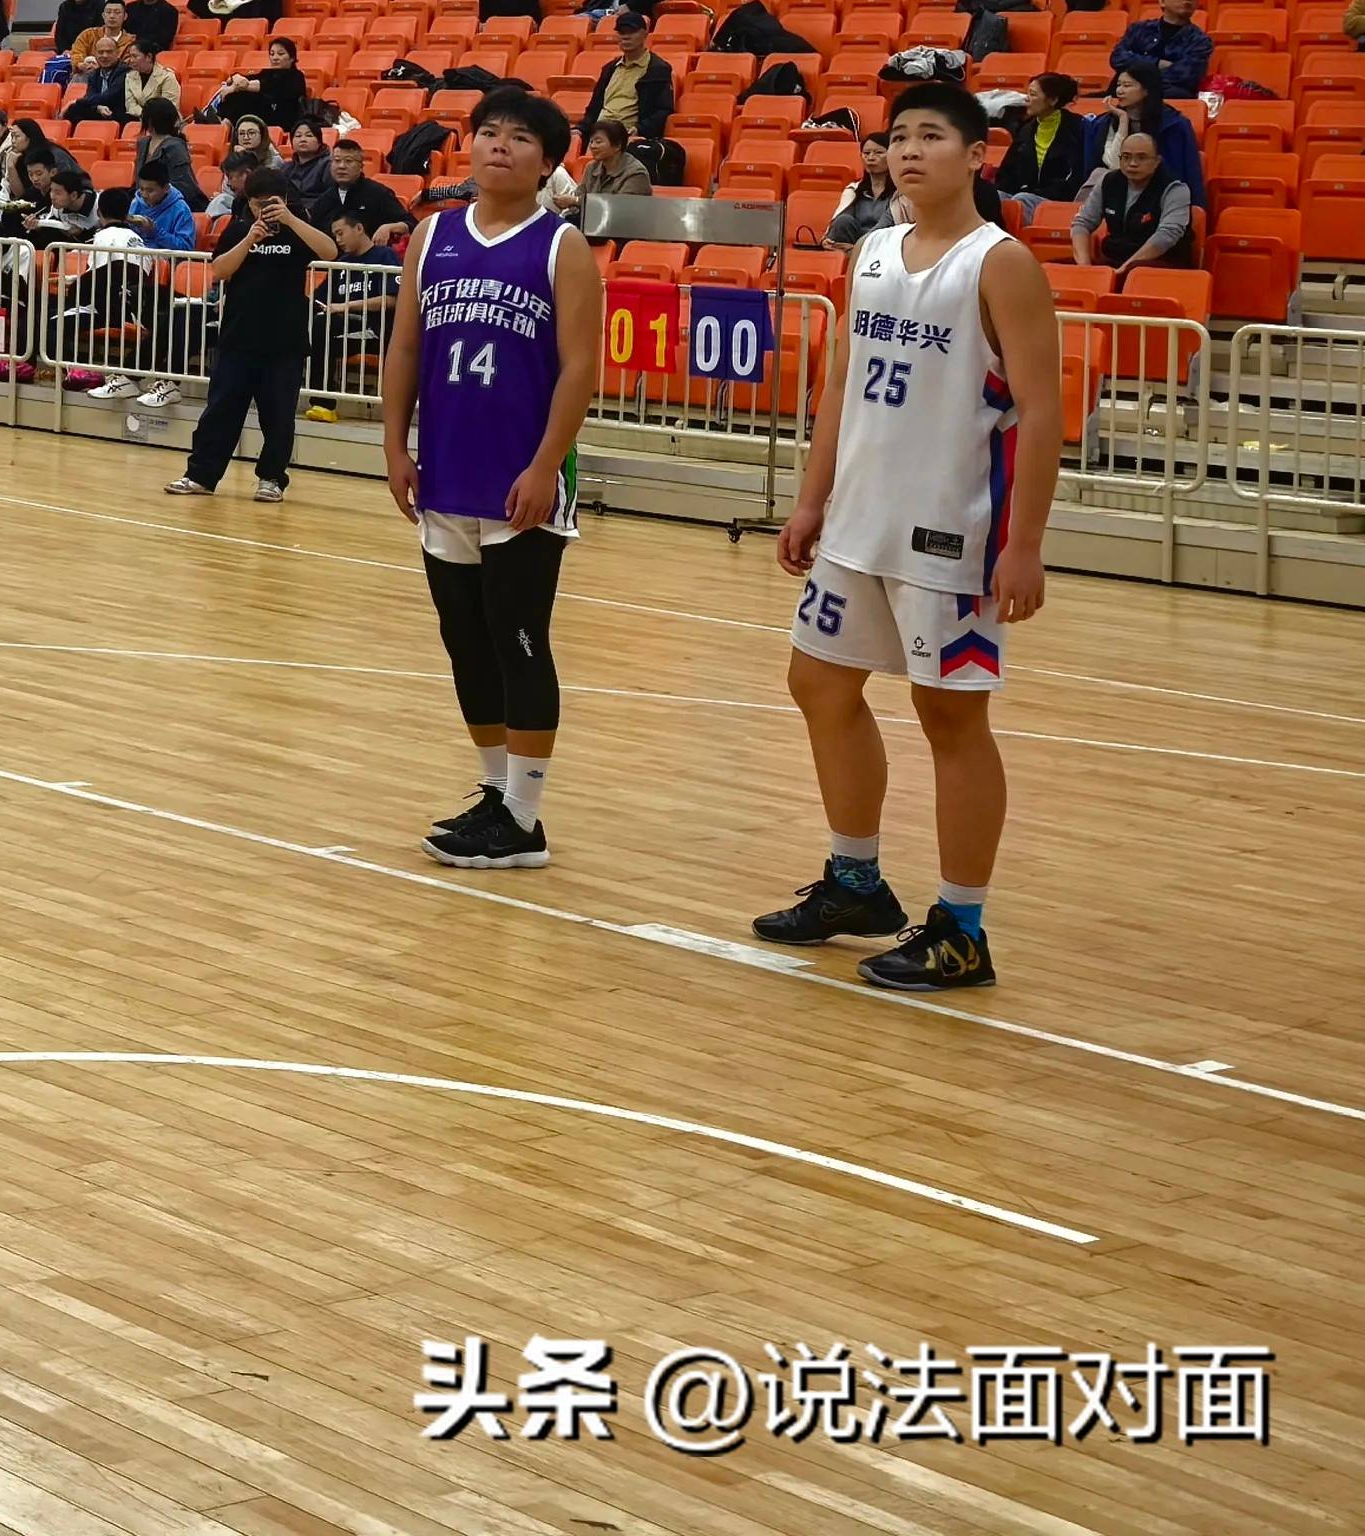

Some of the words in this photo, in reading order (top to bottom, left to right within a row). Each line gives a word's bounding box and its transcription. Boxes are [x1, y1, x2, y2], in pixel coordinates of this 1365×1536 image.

[853, 309, 953, 355] 明德华兴
[447, 338, 497, 388] 14
[863, 355, 913, 408] 25
[797, 579, 848, 638] 25
